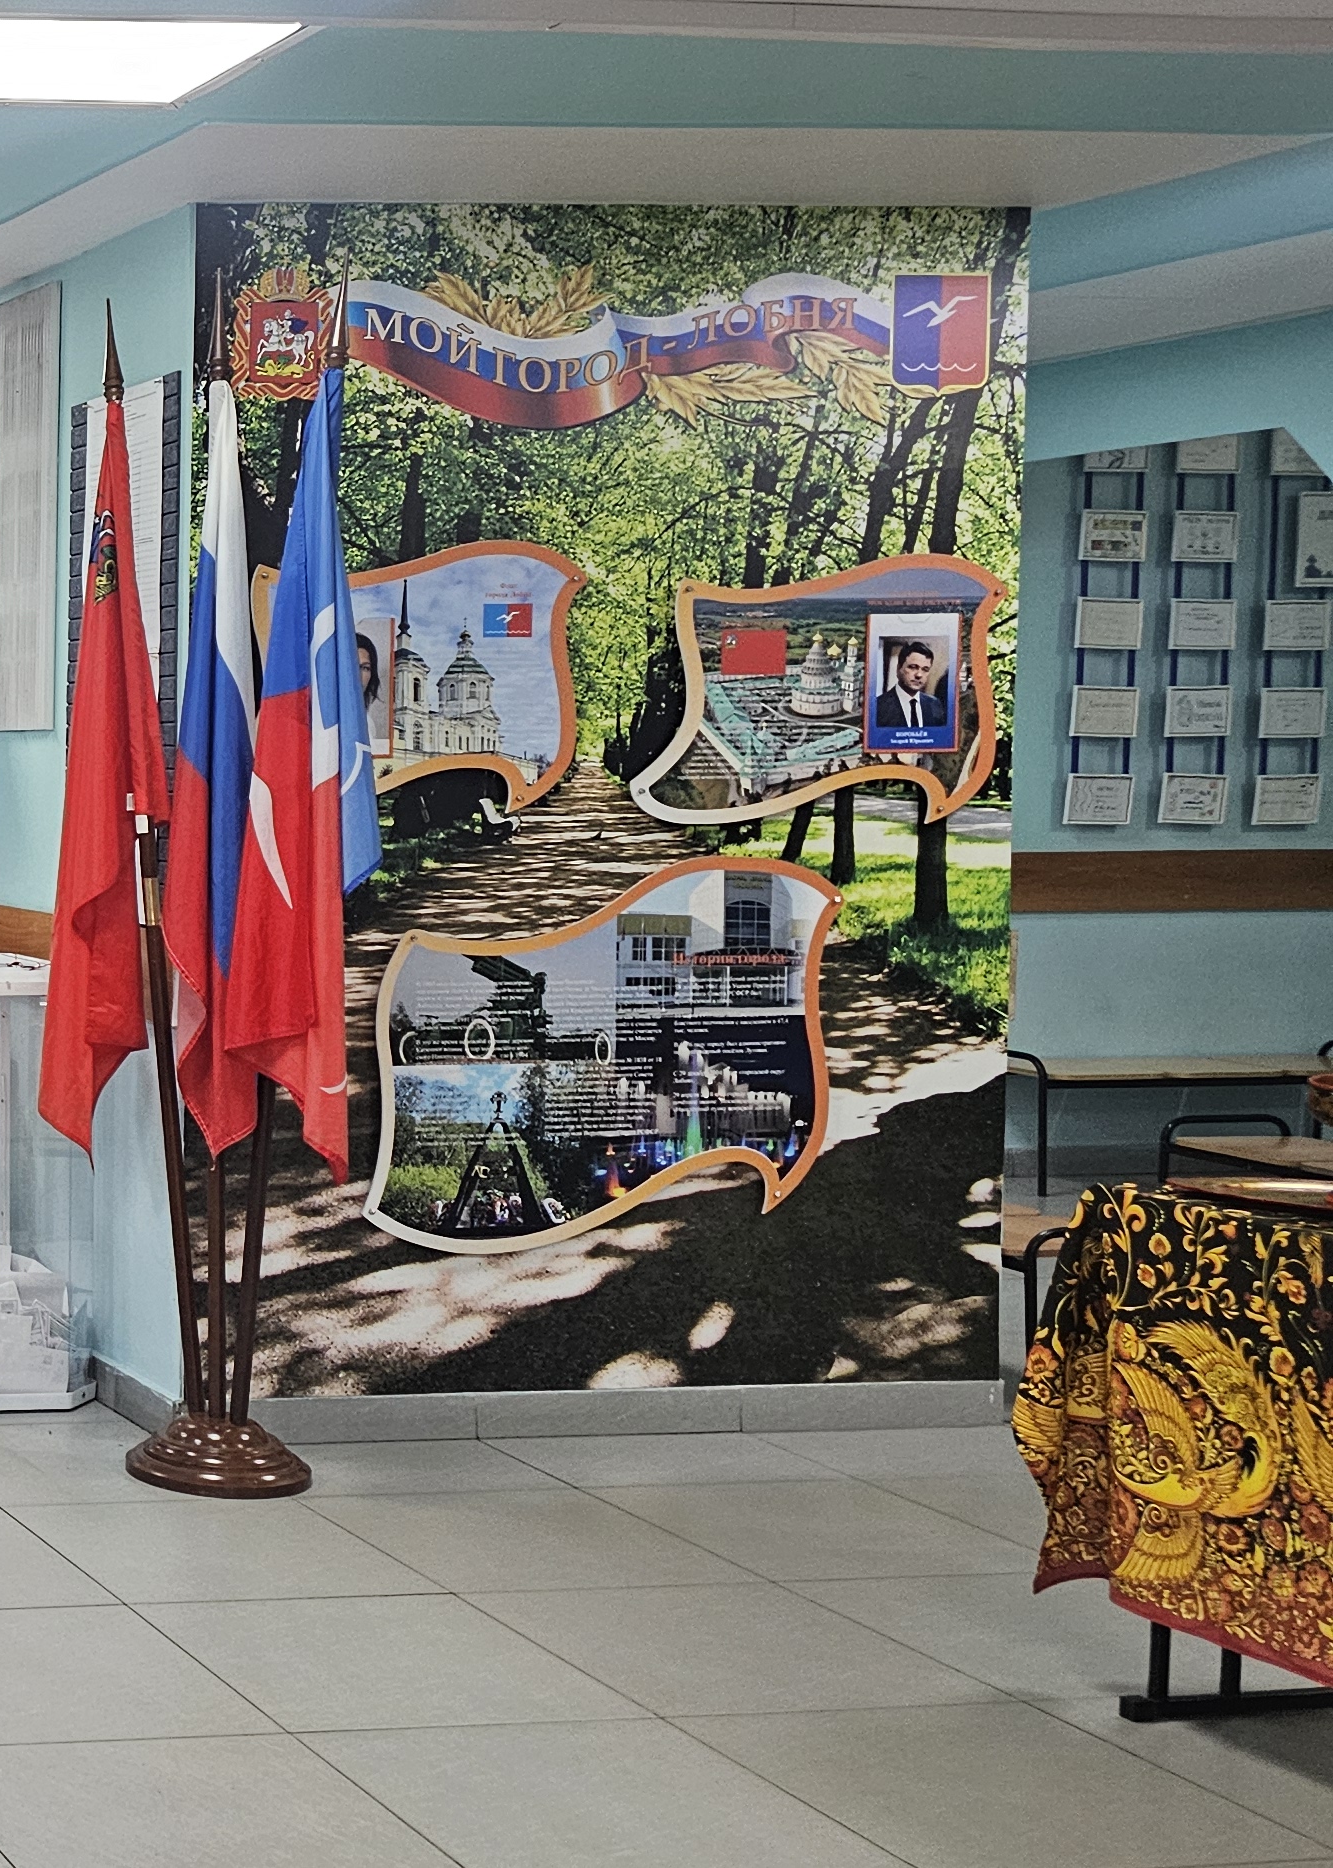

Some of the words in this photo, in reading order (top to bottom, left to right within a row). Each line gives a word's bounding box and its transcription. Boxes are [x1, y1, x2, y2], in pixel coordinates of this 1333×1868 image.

[364, 307, 481, 374] МОЙ
[492, 335, 652, 393] ГОРОД
[687, 296, 857, 350] ЛОБНЯ
